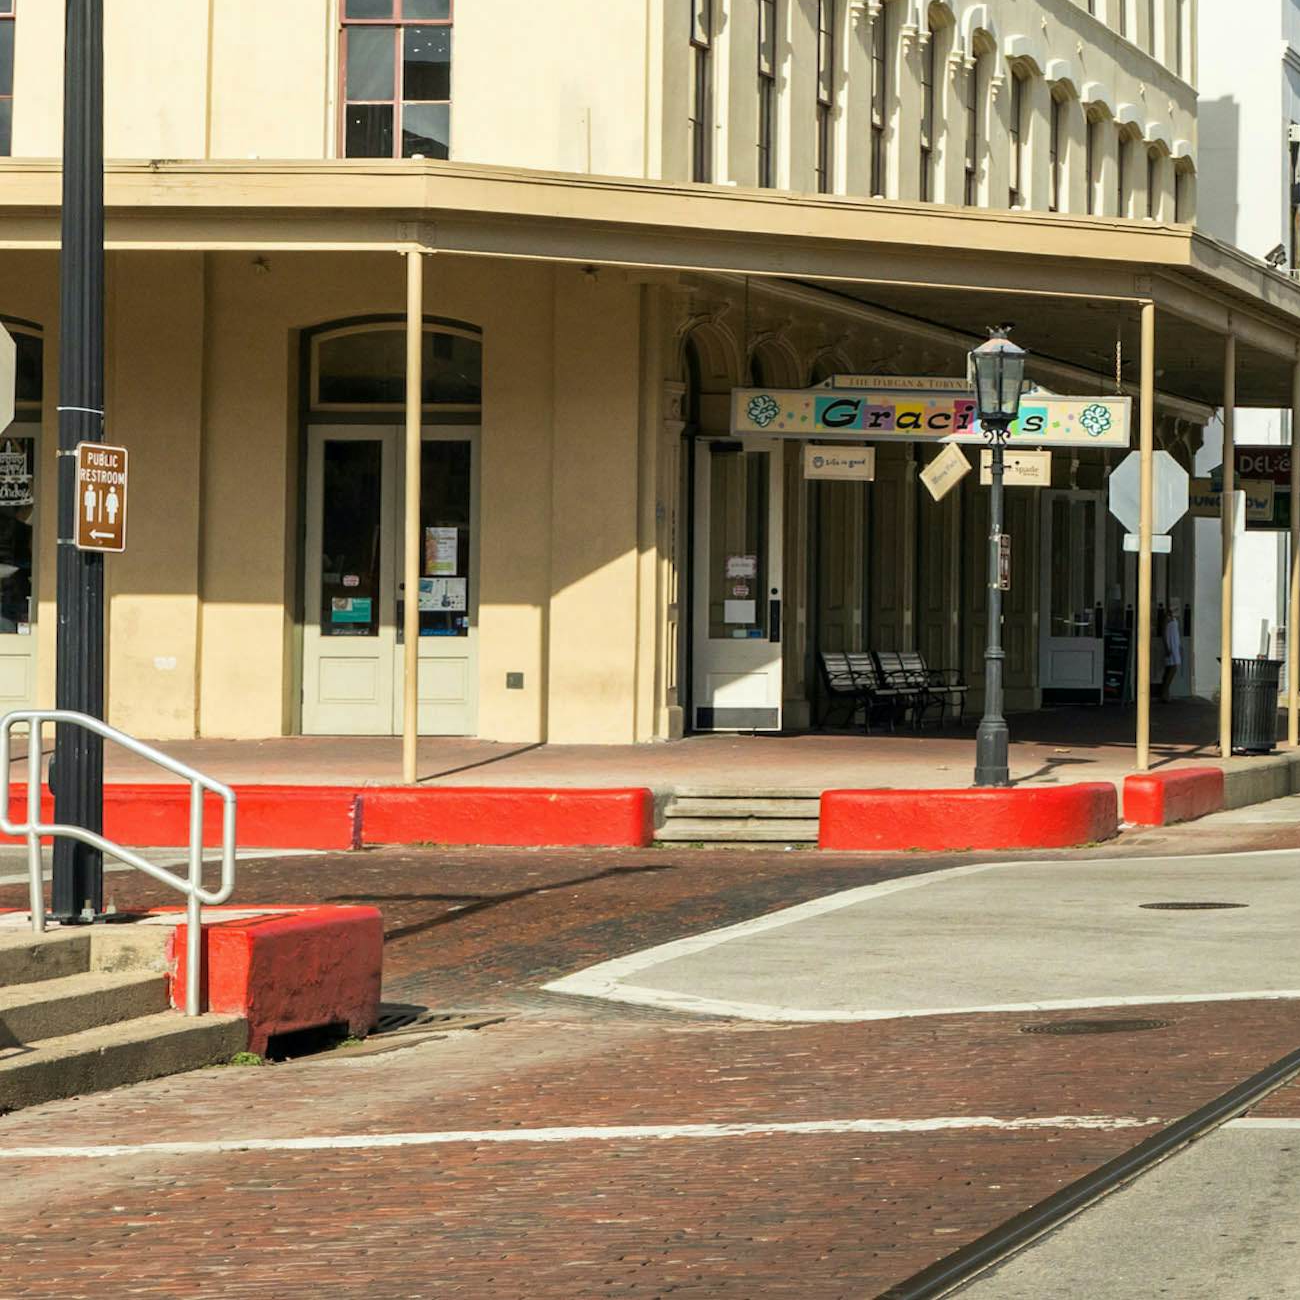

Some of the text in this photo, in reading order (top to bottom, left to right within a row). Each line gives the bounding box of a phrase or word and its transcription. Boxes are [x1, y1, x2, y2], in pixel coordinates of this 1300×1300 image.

[848, 378, 869, 387] THE
[820, 398, 1045, 432] Gracis
[88, 452, 119, 468] PUBLIC
[1239, 456, 1274, 473] DEL
[80, 468, 126, 485] RESTROOM
